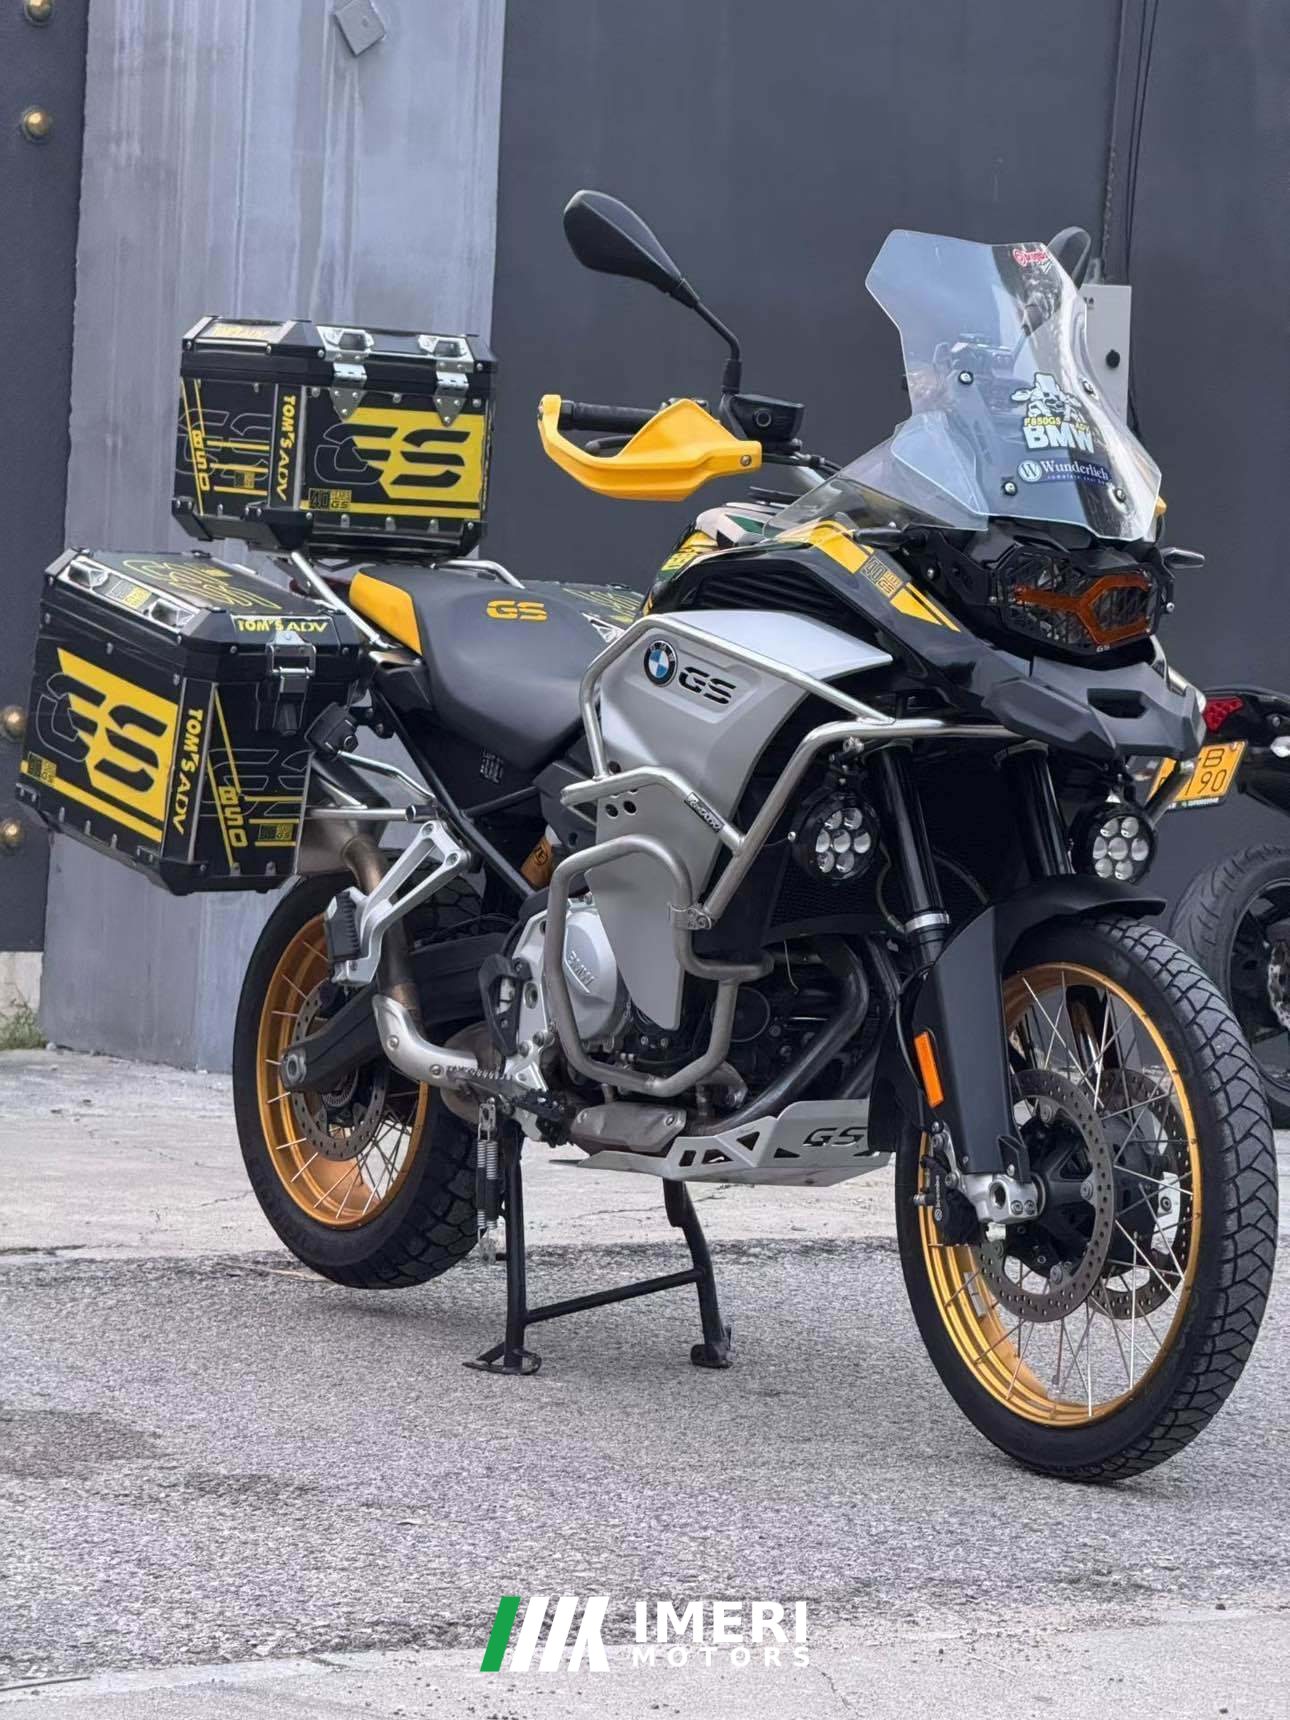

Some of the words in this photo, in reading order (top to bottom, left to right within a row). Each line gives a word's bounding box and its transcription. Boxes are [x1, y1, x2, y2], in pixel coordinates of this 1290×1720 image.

[280, 395, 296, 449] TOM'S
[1023, 420, 1095, 454] BMW
[276, 449, 290, 501] ADV
[1040, 459, 1110, 481] Wunderlich
[237, 619, 284, 632] TOM'S
[287, 621, 329, 632] ADV
[486, 600, 548, 622] GS
[679, 667, 736, 704] GS
[181, 708, 204, 773] TOM'S
[173, 770, 191, 834] ADV
[802, 1126, 868, 1147] GS
